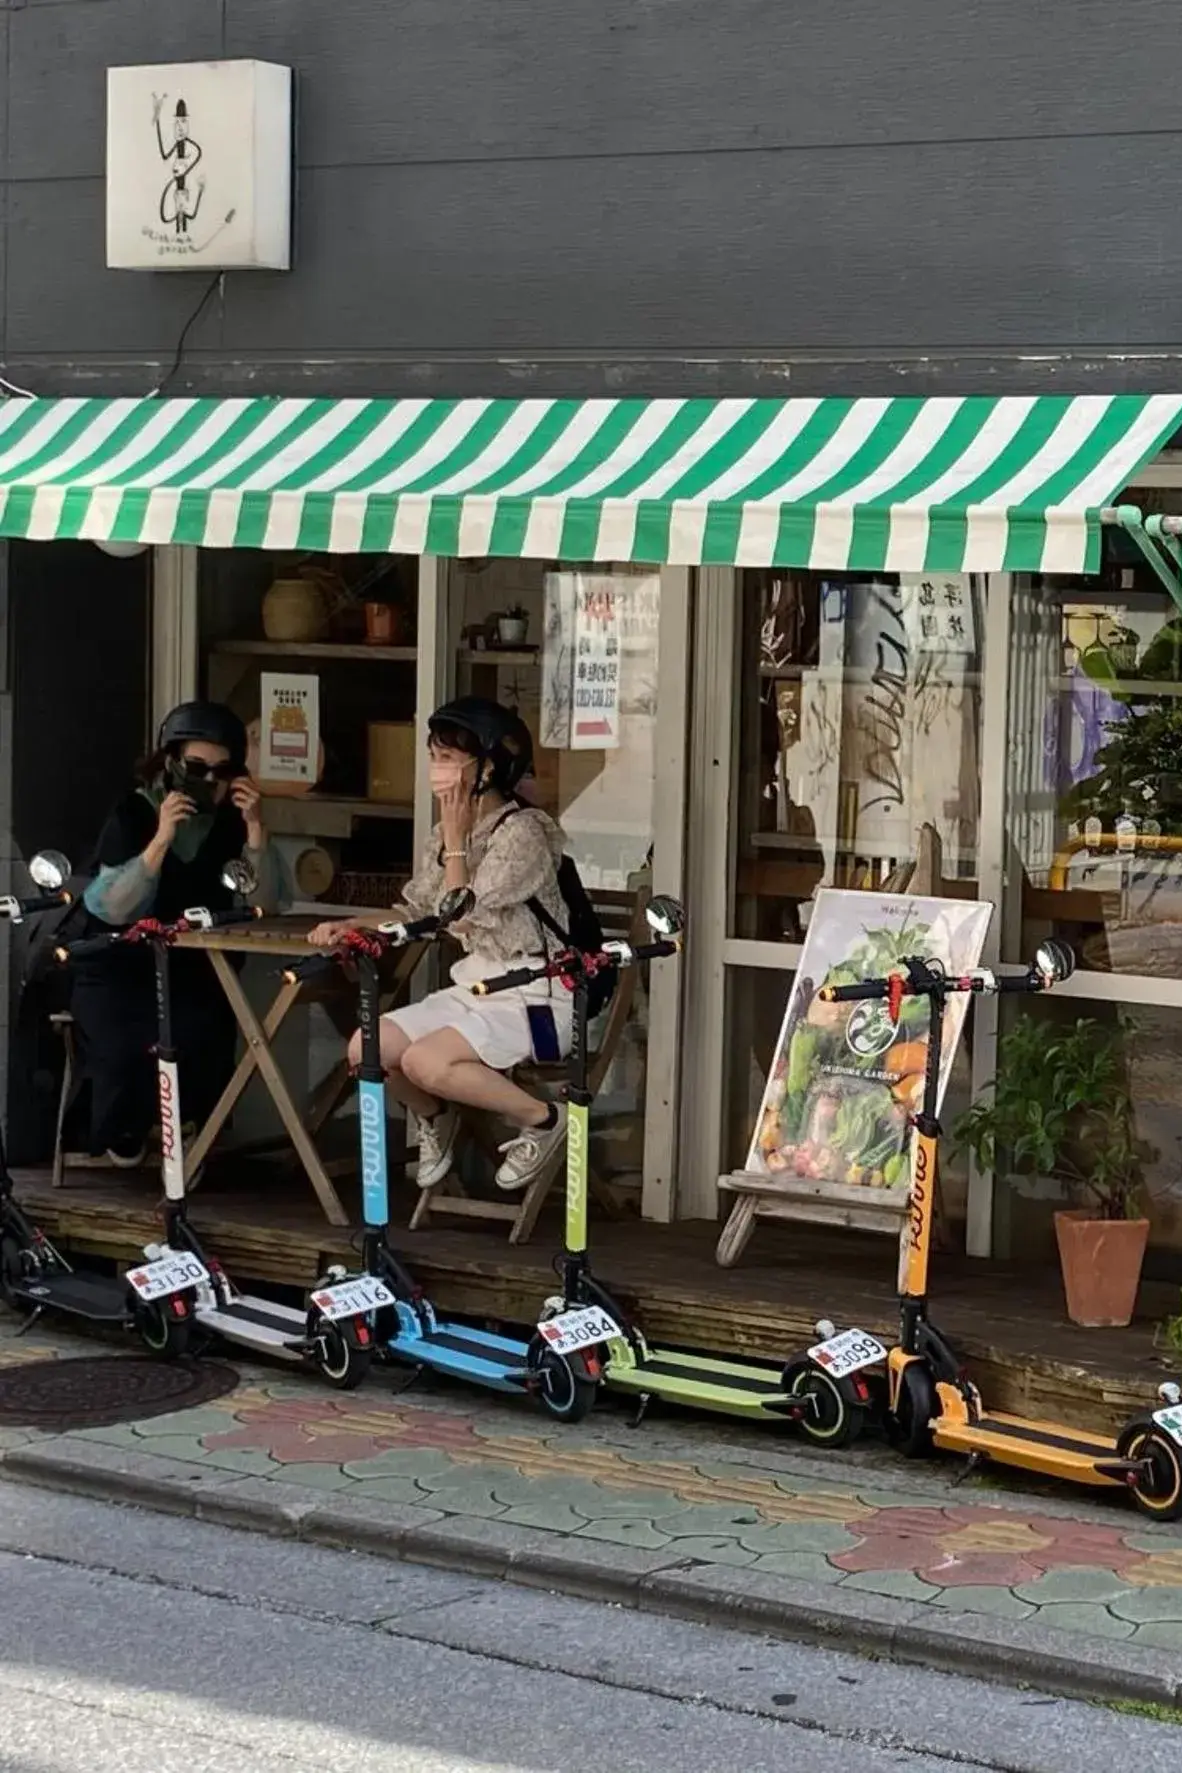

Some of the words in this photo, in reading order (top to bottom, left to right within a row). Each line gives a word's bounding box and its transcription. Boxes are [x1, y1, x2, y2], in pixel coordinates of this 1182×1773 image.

[151, 1263, 203, 1290] 3130
[336, 1286, 388, 1311] 3116
[564, 1317, 616, 1344] 3084
[835, 1338, 882, 1367] 3099
